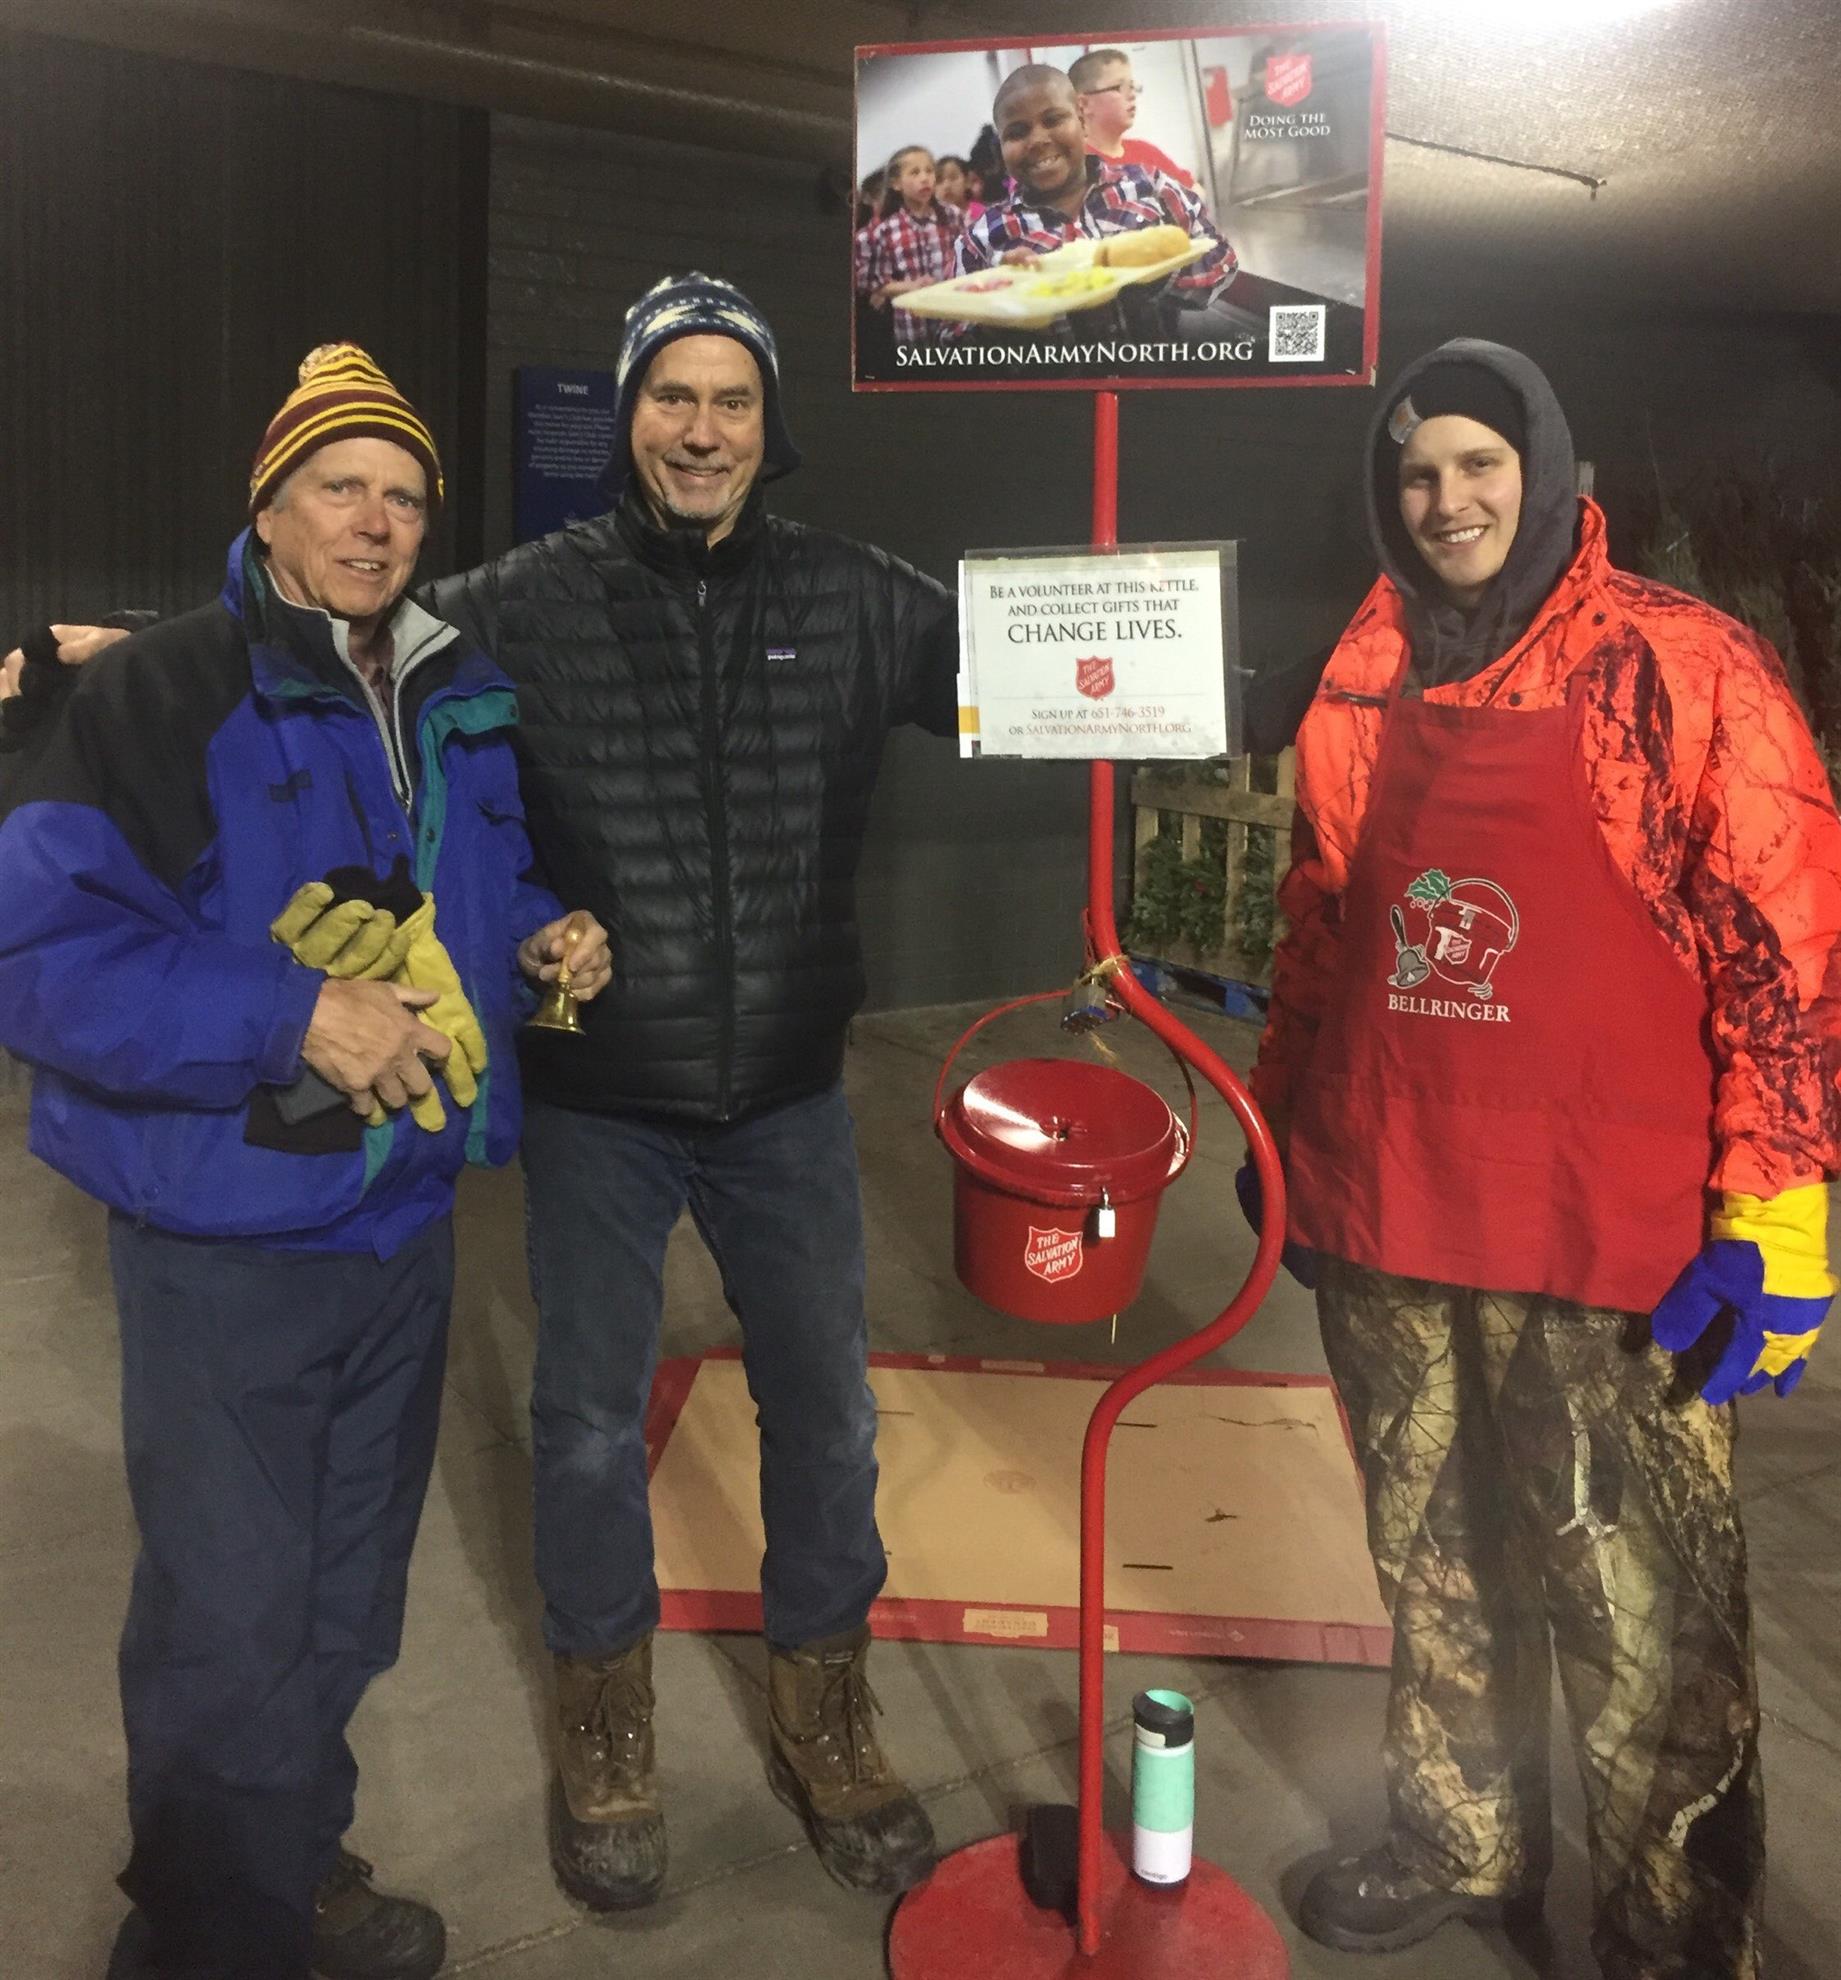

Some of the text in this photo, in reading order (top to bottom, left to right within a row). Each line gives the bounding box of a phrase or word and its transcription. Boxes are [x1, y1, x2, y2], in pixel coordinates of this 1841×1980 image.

[1249, 114, 1296, 127] DOING
[1244, 125, 1331, 139] MOST GOOD
[557, 383, 589, 395] TWINE
[990, 585, 1004, 599] BE
[1007, 587, 1016, 598] A
[1018, 583, 1093, 598] VOLUNTEER
[1096, 582, 1112, 595] AT
[1116, 581, 1146, 594] THIS
[1008, 598, 1180, 616] AND COLLECT GIFTS THAT
[1007, 618, 1182, 643] CHANGE LIVES.
[1032, 705, 1165, 720] SIGN UP AT 651-746-3519
[1008, 725, 1023, 736] OR
[1388, 994, 1511, 1023] BELLRINGER
[1036, 1233, 1060, 1249] THE
[1027, 1236, 1079, 1266] SALVATION
[1043, 1252, 1076, 1276] ARMY
